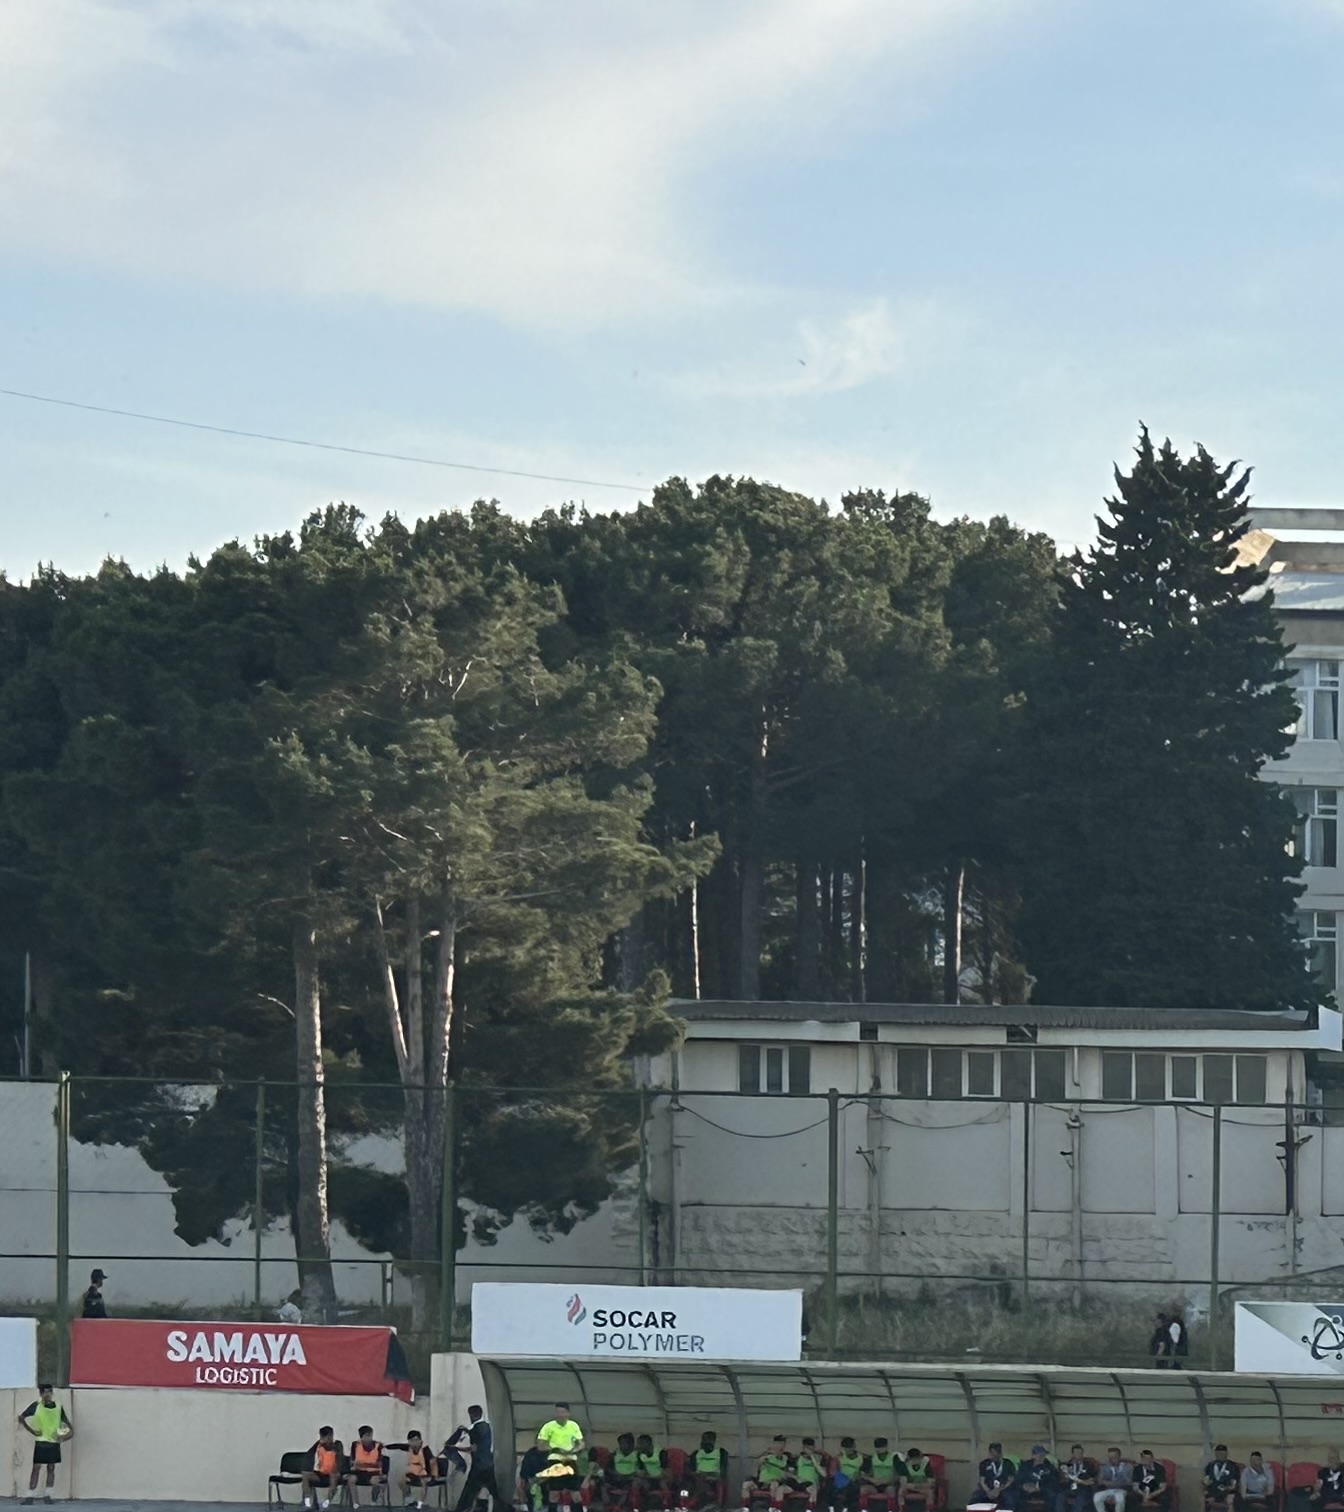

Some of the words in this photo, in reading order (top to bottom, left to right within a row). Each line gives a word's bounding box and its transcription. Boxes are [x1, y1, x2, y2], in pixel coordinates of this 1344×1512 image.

[593, 1309, 677, 1329] SOCAR
[166, 1330, 307, 1365] SAMAYA
[593, 1333, 705, 1352] POLYMER
[195, 1366, 278, 1385] LOGISTIC
